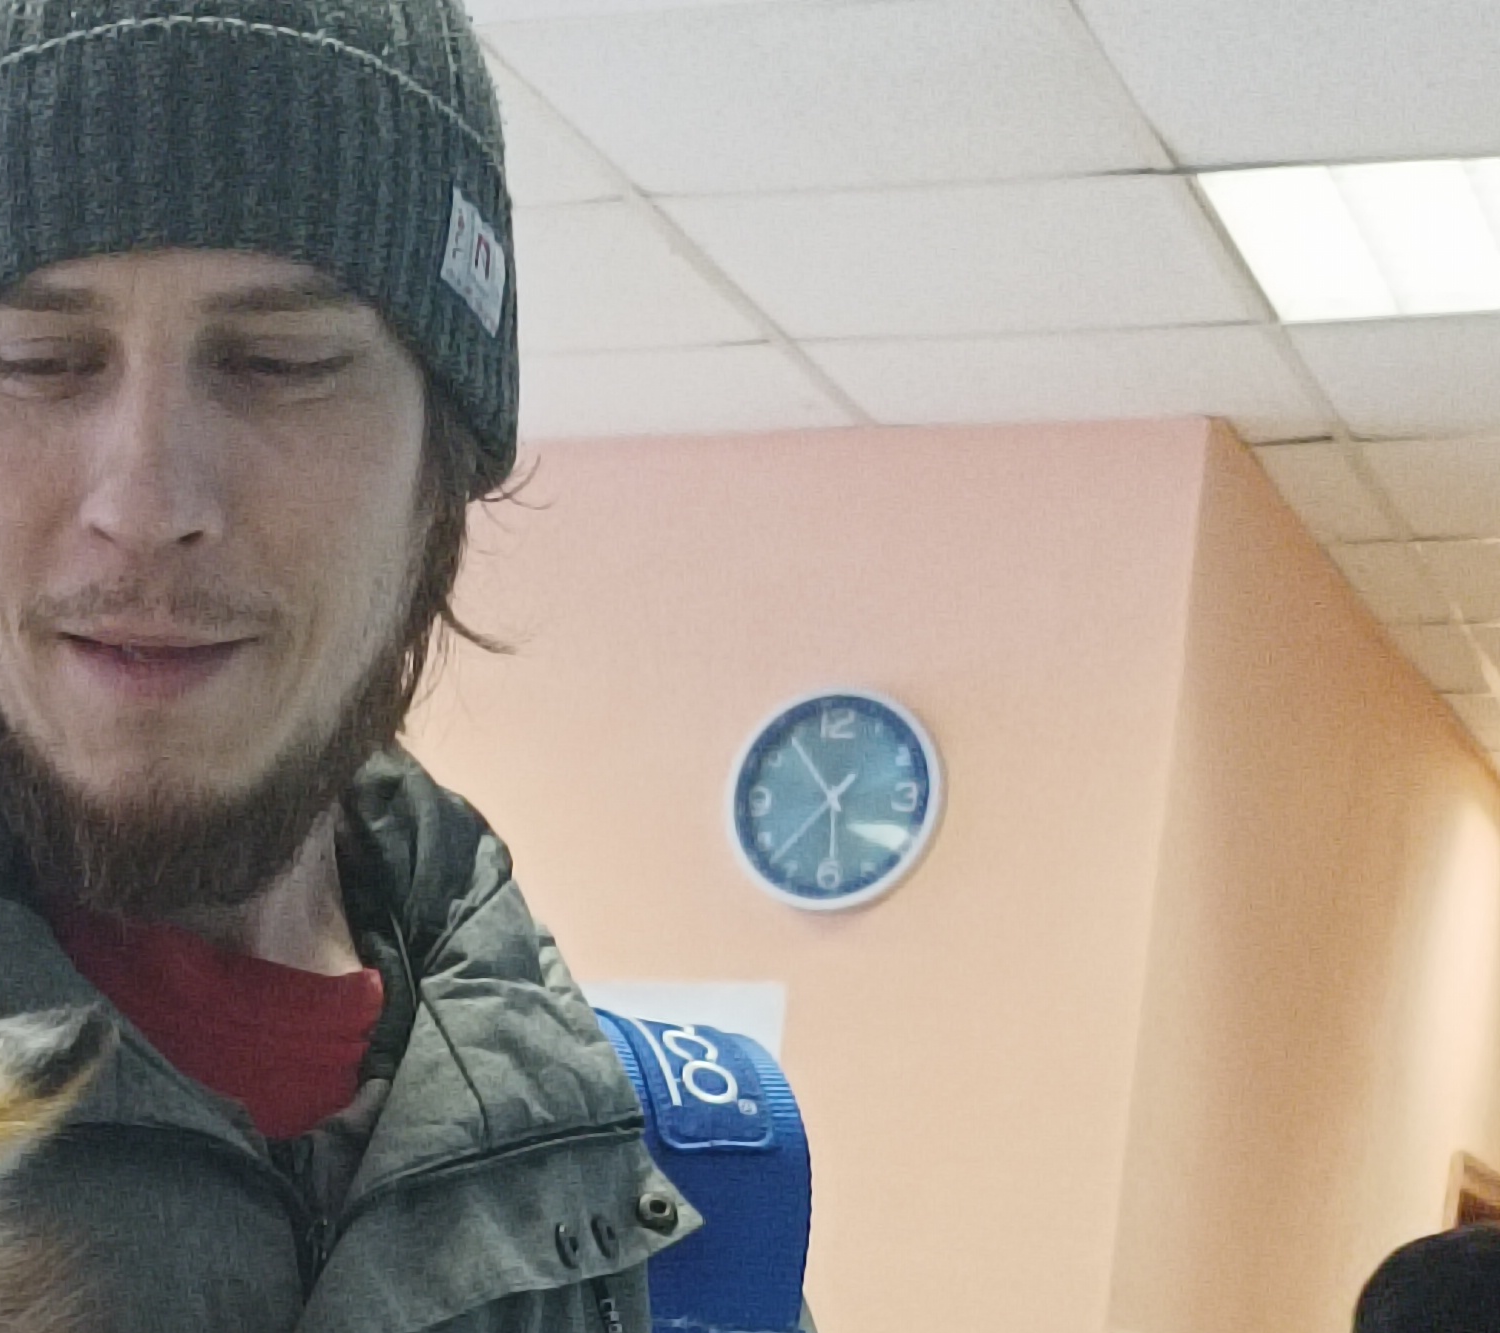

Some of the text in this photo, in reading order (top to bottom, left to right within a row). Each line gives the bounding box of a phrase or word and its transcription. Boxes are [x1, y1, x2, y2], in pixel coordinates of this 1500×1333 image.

[820, 707, 856, 739] 12
[750, 785, 773, 818] 9
[890, 781, 918, 813] 3
[816, 857, 841, 890] 6
